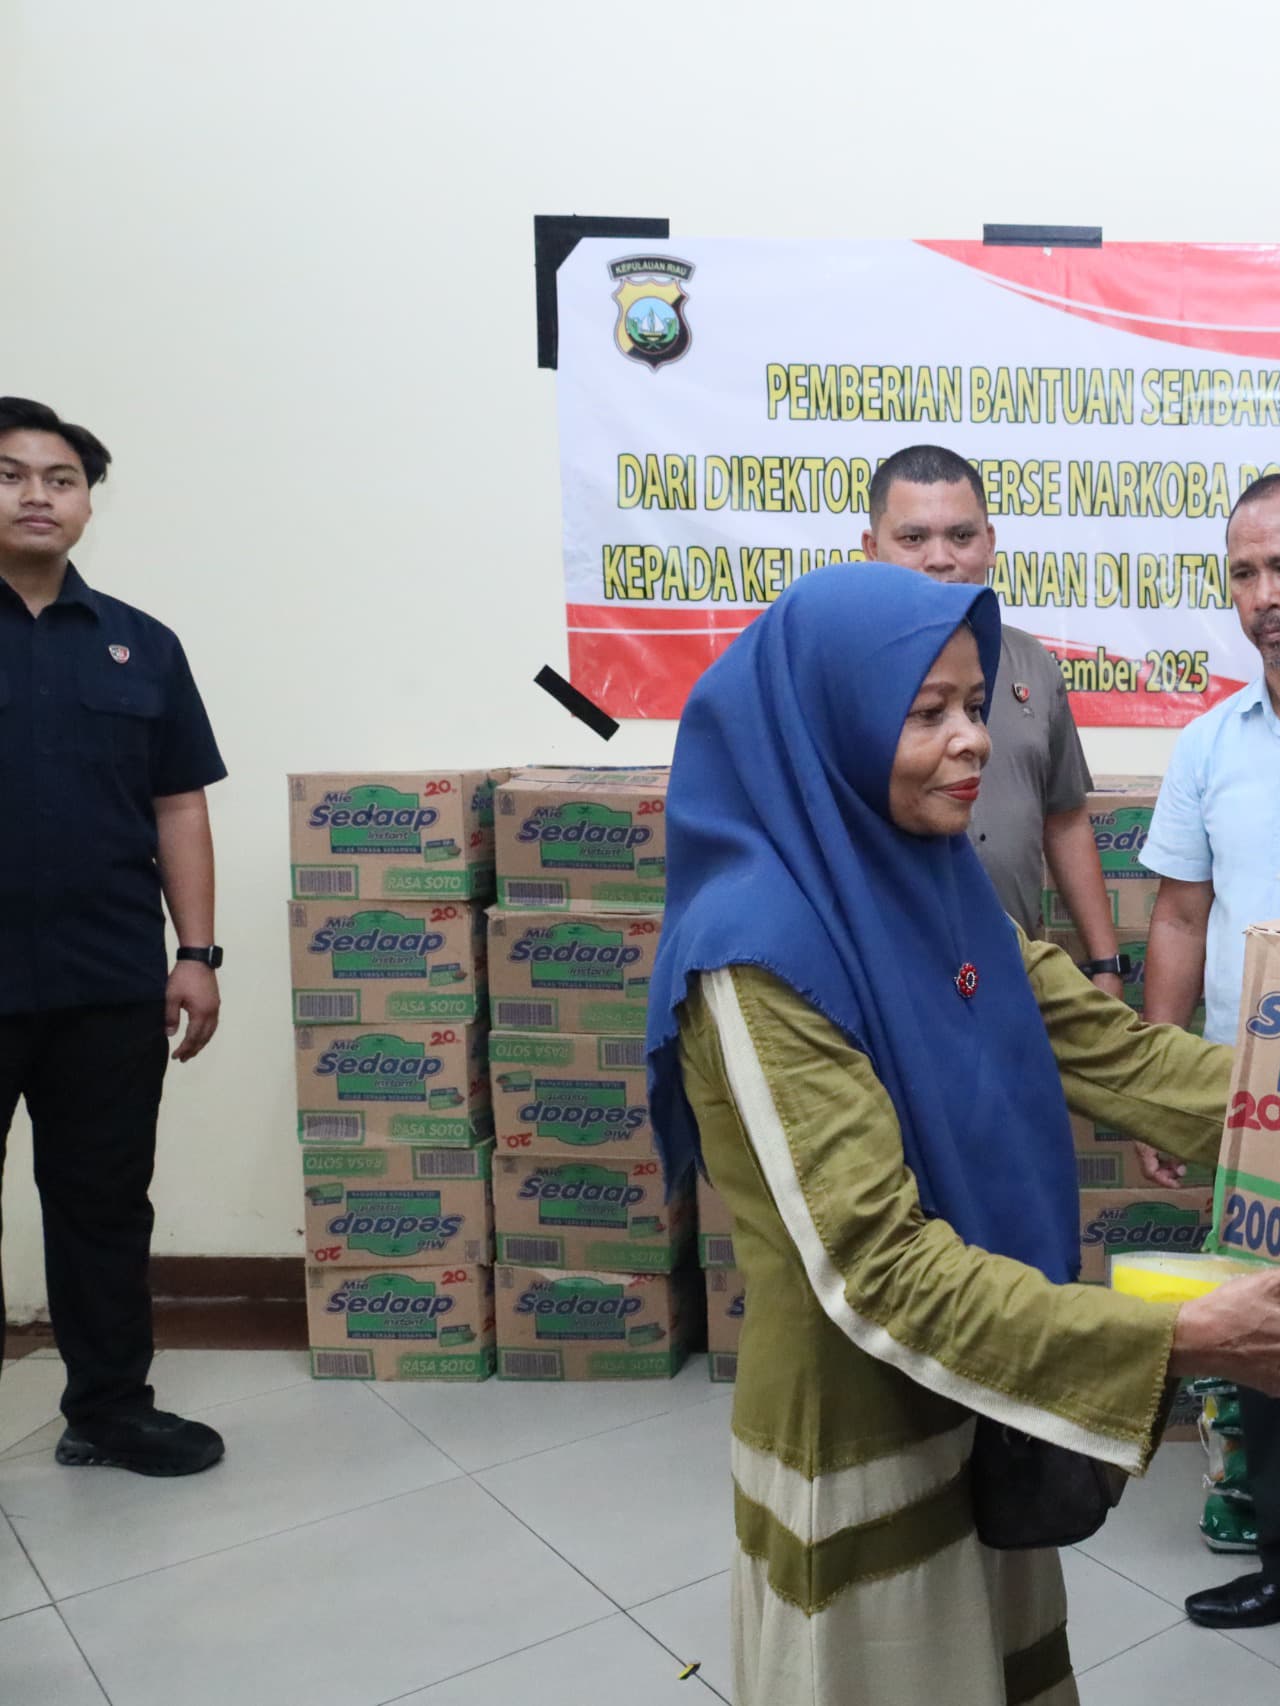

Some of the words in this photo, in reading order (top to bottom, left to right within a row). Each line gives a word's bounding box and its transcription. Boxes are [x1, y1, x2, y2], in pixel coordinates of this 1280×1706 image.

[614, 260, 665, 275] KEPULAUAN
[666, 263, 688, 276] RIAU
[766, 363, 961, 422] PEMBERIAN
[970, 366, 1133, 426] BANTUAN
[617, 454, 697, 510] DARI
[704, 455, 889, 513] DIREKTOR
[966, 458, 1061, 516] ERSE
[1067, 460, 1231, 517] NARKOBA
[602, 545, 738, 602] KEPADA
[986, 552, 1087, 608] ANAN
[1094, 552, 1130, 608] DI
[1051, 646, 1142, 692] ember
[1145, 650, 1209, 693] 2025
[424, 780, 451, 797] 20
[324, 791, 353, 803] Mie
[534, 806, 563, 818] Mie
[637, 800, 665, 816] 20
[308, 802, 439, 833] Sedaap
[517, 819, 652, 848] Sedaap
[386, 876, 420, 889] RASA
[424, 876, 461, 889] SOTO
[430, 906, 457, 922] 20
[326, 917, 356, 929] Mie
[628, 921, 655, 937] 20
[525, 928, 554, 938] Mie
[308, 928, 445, 957] Sedaap
[509, 940, 642, 969] Sedaap
[430, 1000, 466, 1013] SOTO
[331, 1039, 359, 1051] Mie
[429, 1029, 456, 1047] 20
[495, 1044, 532, 1057] SOTO
[315, 1052, 443, 1081] Sedaap
[519, 1101, 648, 1129] Sedaap
[430, 1123, 465, 1136] SOTO
[604, 1129, 632, 1141] Mie
[506, 1132, 533, 1148] 20
[306, 1156, 344, 1170] SOTO
[632, 1162, 657, 1176] 20
[518, 1177, 645, 1208] Sedaap
[328, 1212, 463, 1239] Sedaap
[416, 1238, 446, 1250] Mie
[314, 1246, 342, 1262] 20
[342, 1279, 369, 1291] Mie
[440, 1269, 467, 1285] 20
[326, 1291, 454, 1318] Sedaap
[515, 1292, 642, 1319] Sedaap
[401, 1360, 436, 1373] RASA
[439, 1359, 476, 1373] SOTO
